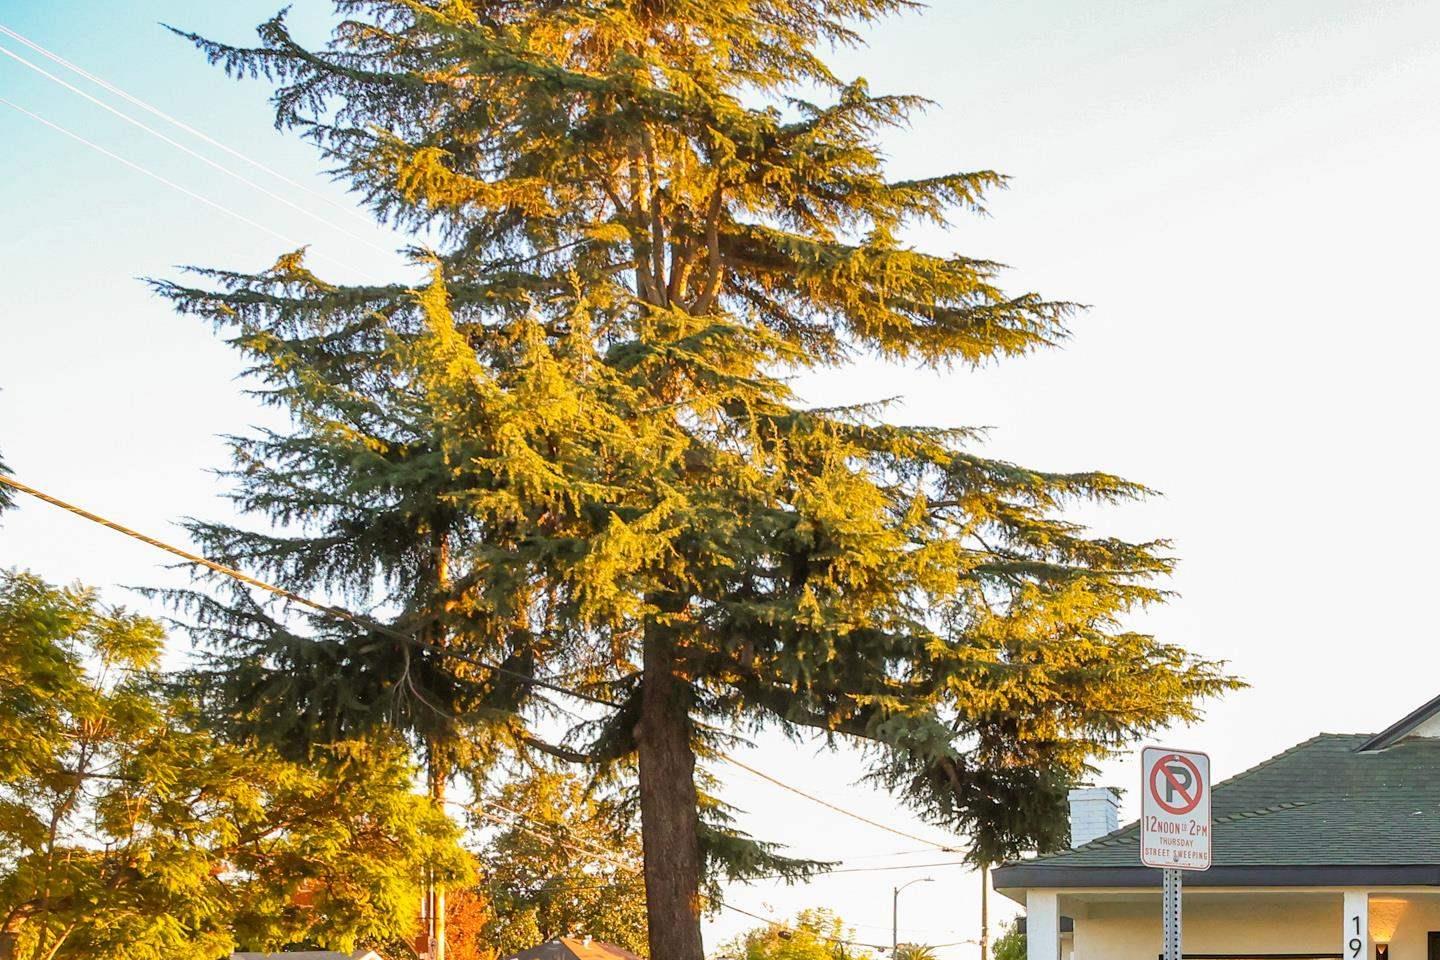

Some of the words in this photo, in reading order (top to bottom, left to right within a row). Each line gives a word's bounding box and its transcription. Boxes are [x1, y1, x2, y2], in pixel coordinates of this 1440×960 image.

[1160, 836, 1194, 848] THURSDAY
[1144, 847, 1170, 858] STREET
[1173, 849, 1208, 860] SWEEPING
